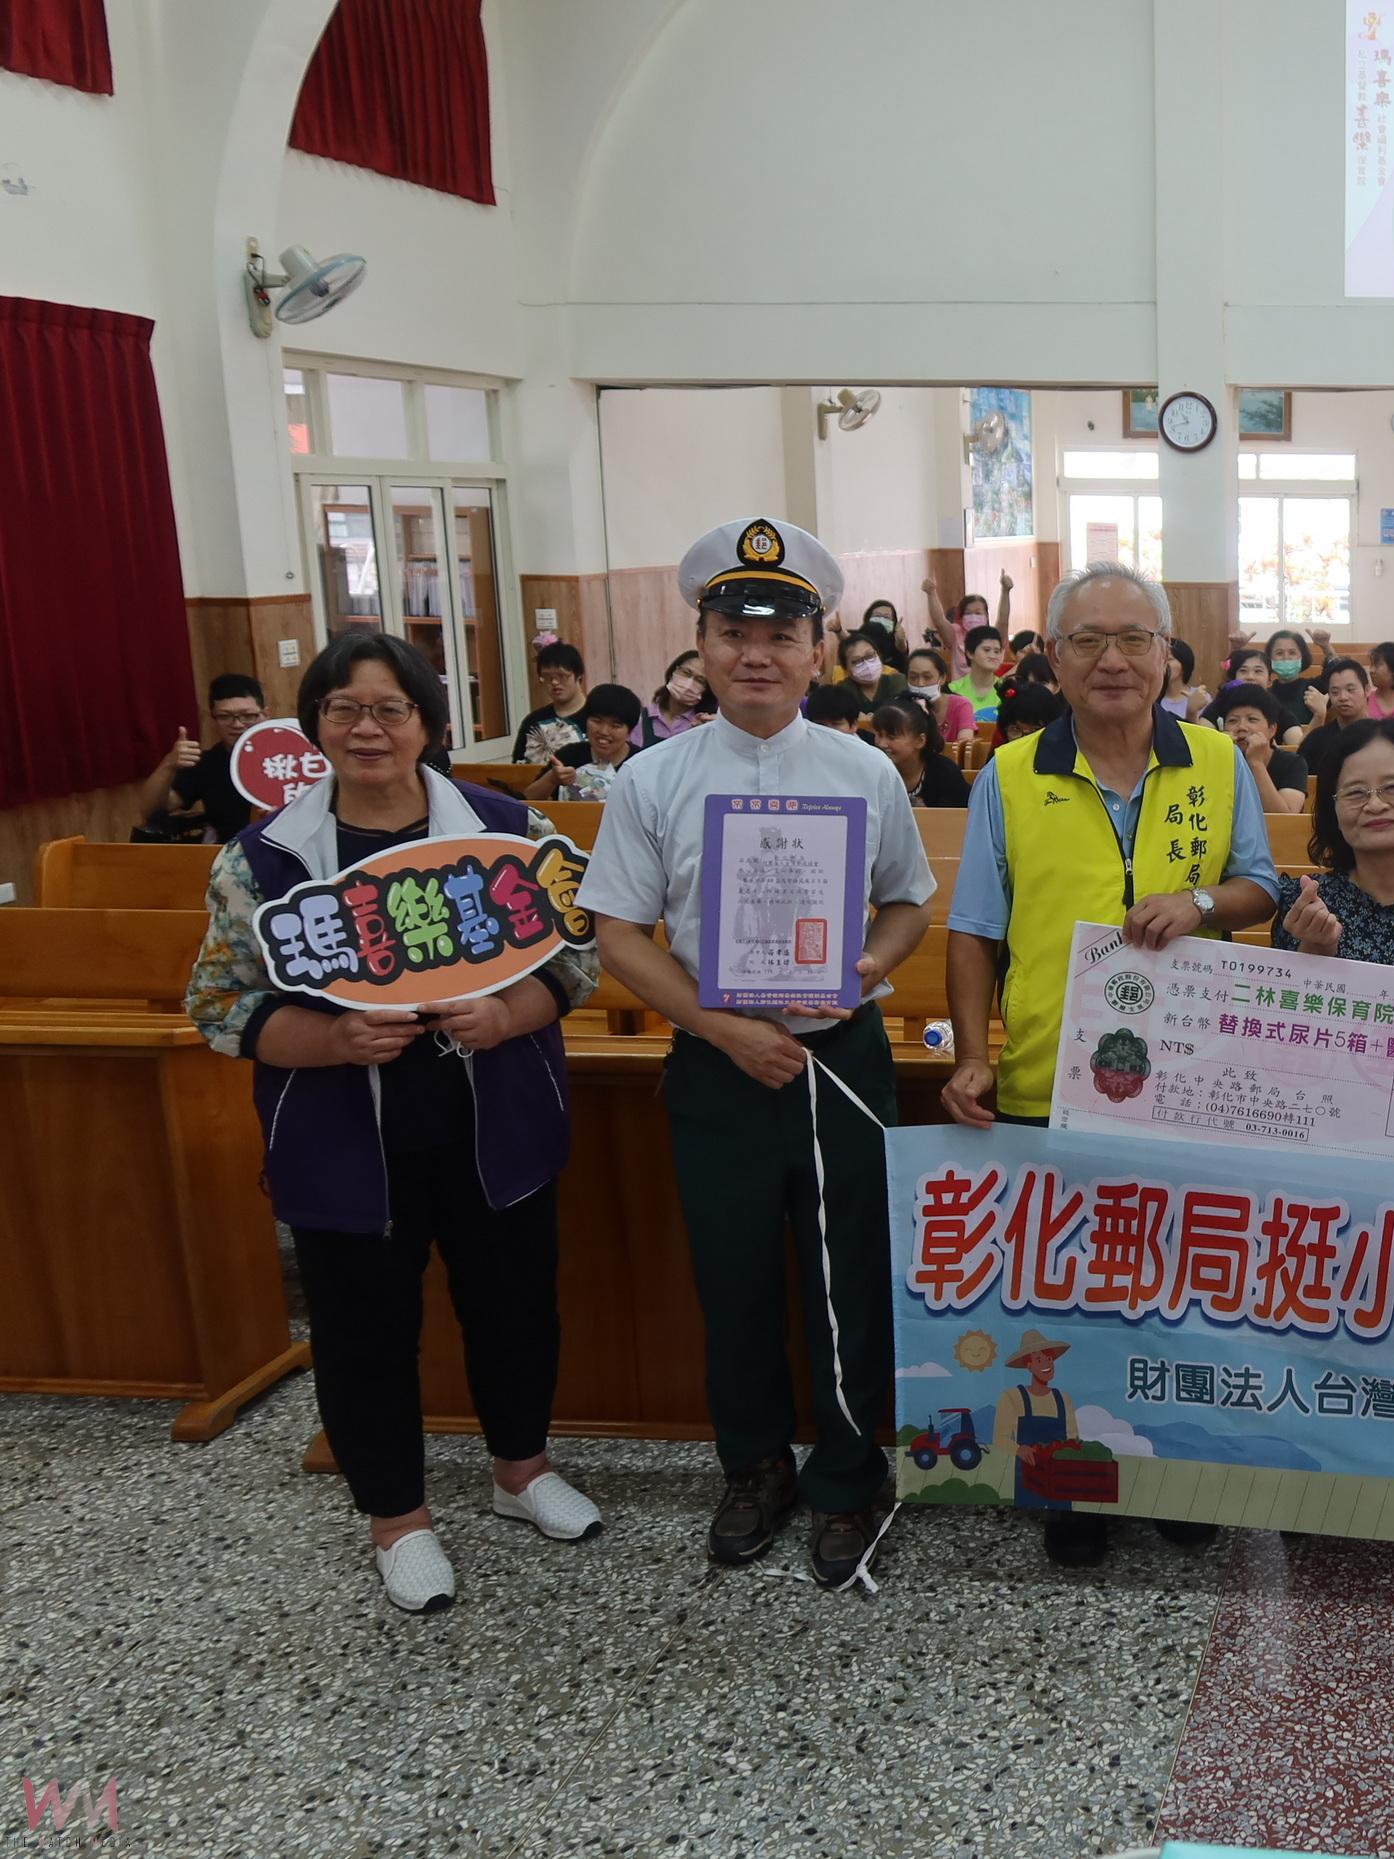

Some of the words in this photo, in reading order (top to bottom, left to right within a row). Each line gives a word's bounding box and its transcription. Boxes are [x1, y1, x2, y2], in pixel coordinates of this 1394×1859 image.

[1164, 804, 1187, 863] 局長
[1186, 785, 1208, 888] 彰化郵局
[760, 837, 804, 850] 感謝狀
[270, 847, 589, 980] 瑪喜樂基金會
[1303, 978, 1346, 993] 中華民國
[1164, 1013, 1211, 1030] 新台幣
[1160, 1039, 1194, 1056] NT$
[1222, 1067, 1258, 1082] 此致
[1245, 1122, 1305, 1140] 03-713-0016
